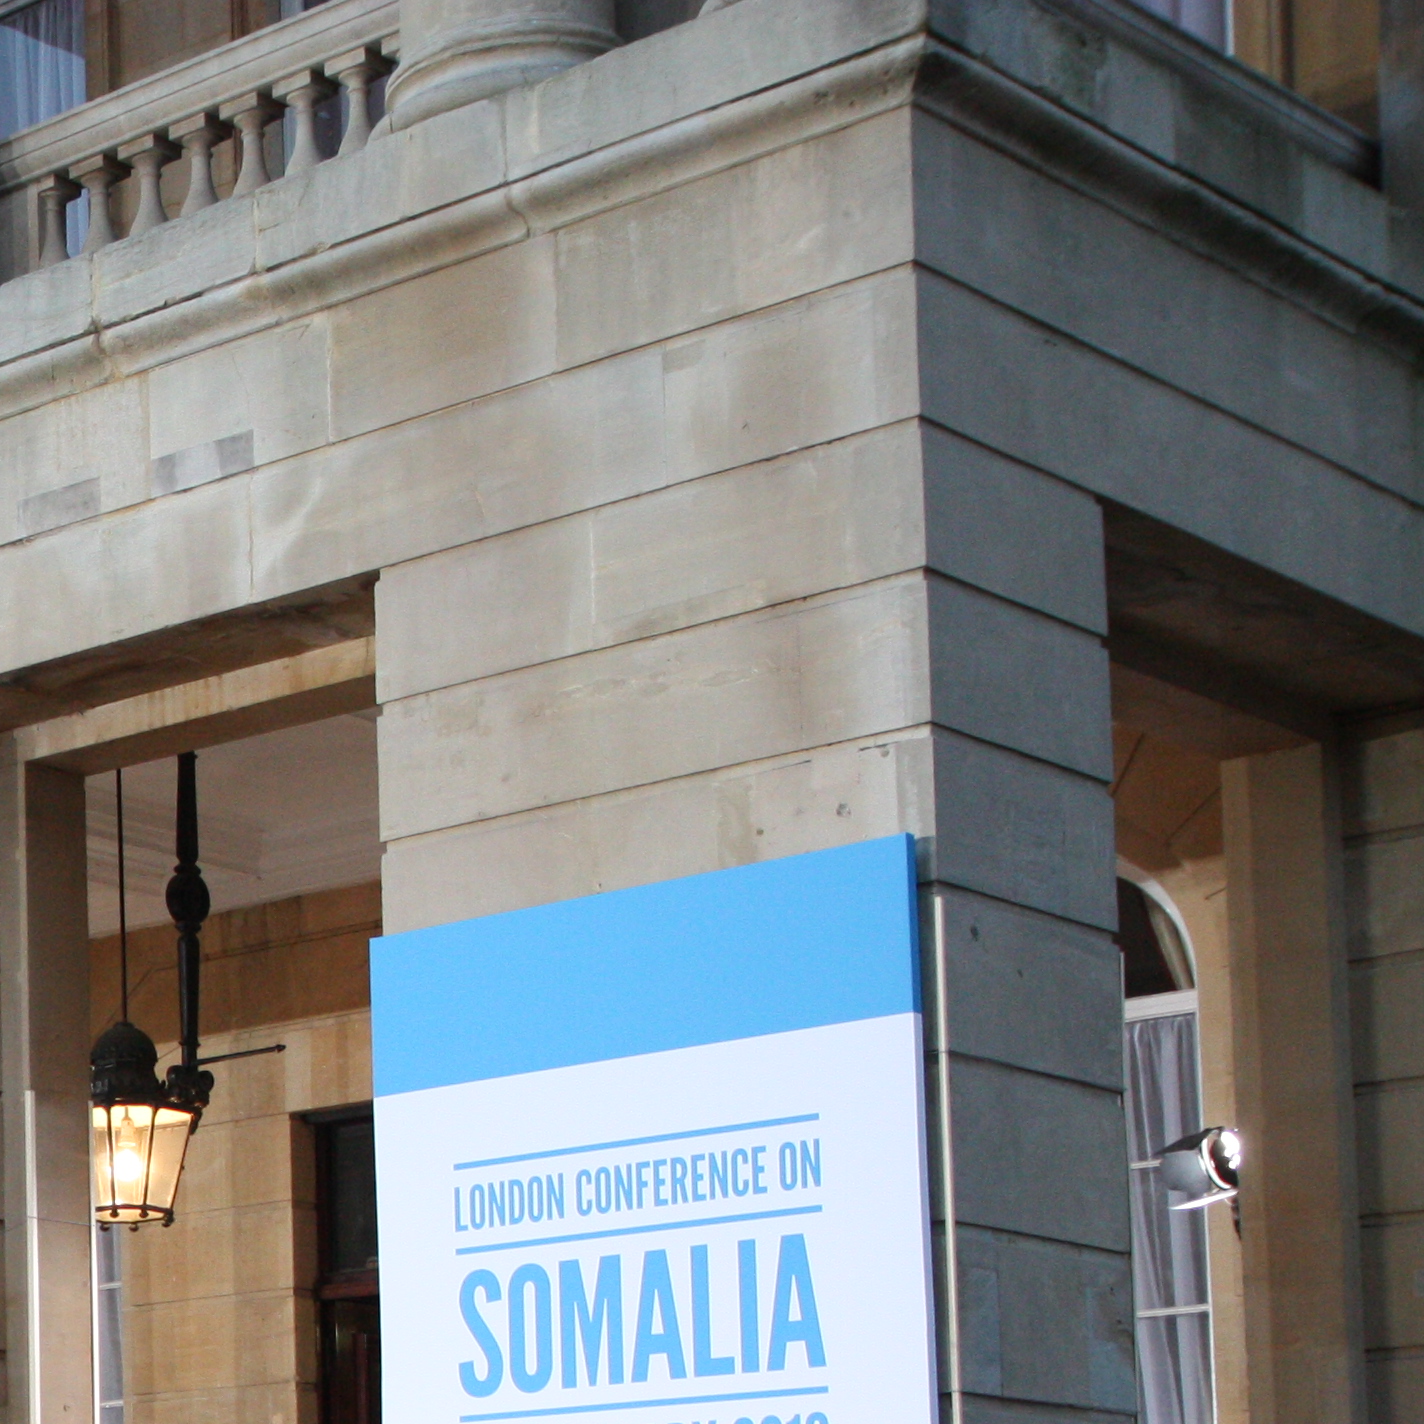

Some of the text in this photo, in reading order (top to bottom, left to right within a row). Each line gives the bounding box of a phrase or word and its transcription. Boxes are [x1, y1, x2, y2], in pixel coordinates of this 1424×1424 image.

[453, 1137, 822, 1233] LONDON CONFERENCE ON
[458, 1232, 827, 1398] SOMALIA
